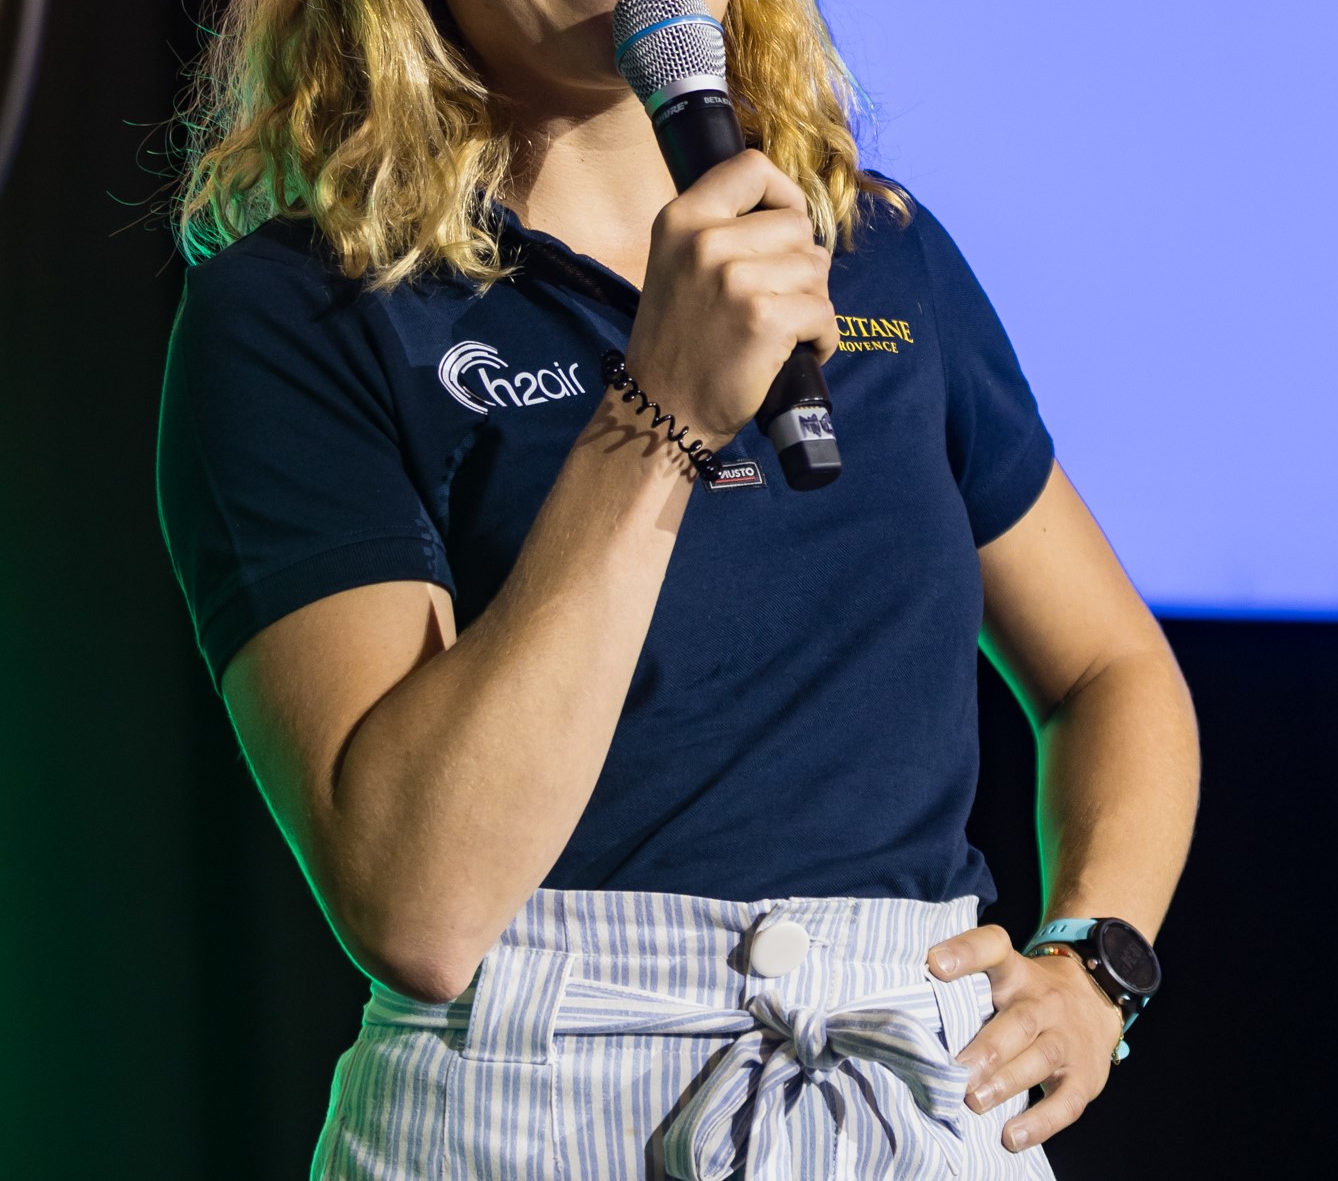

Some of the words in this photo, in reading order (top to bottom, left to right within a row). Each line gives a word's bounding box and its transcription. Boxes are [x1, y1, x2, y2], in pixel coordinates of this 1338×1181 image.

[833, 314, 914, 344] CITANE
[838, 340, 899, 354] ROVENCE
[478, 361, 586, 407] h2air
